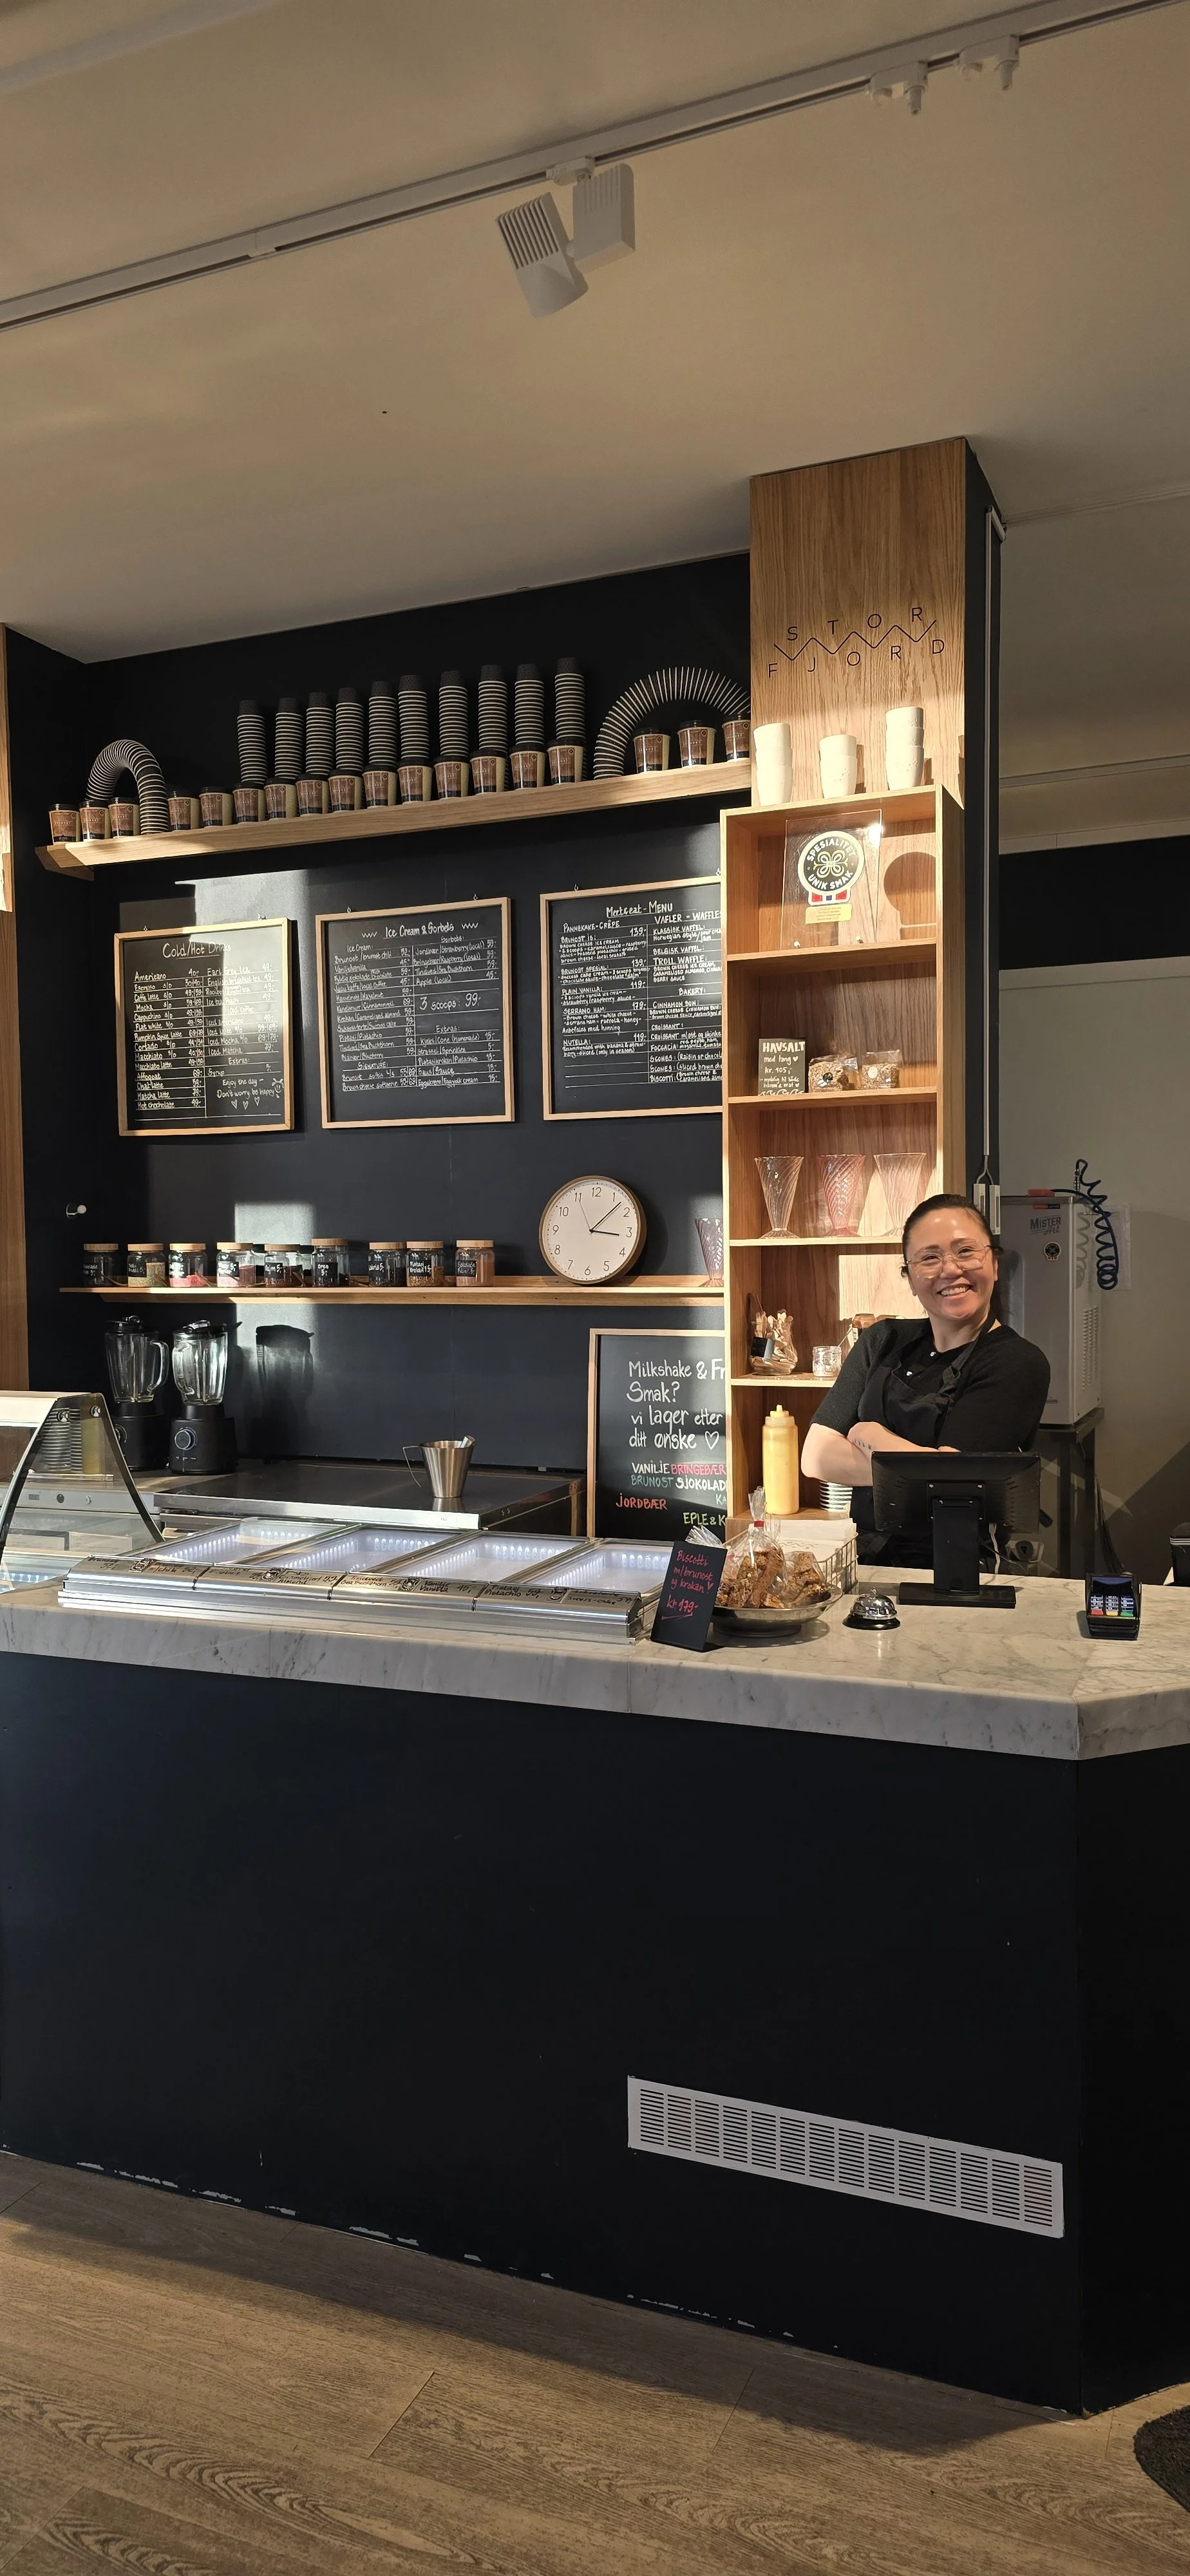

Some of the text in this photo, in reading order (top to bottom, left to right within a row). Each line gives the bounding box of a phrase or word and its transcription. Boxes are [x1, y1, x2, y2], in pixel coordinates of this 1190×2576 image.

[807, 838, 856, 862] SPESIALITET
[808, 870, 853, 890] UNIK SMAK
[654, 913, 683, 924] VAFLER
[386, 927, 397, 938] Ice
[399, 925, 420, 937] Cream
[428, 922, 454, 934] Sorbets
[163, 941, 231, 958] Cold/Hot Drinks
[653, 957, 675, 966] TROLL
[135, 971, 166, 981] Americano
[207, 968, 222, 976] Earl
[416, 978, 432, 988] Apple
[419, 996, 428, 1010] 3
[134, 1041, 158, 1051] Cortado
[208, 1046, 221, 1056] Iced
[762, 1041, 805, 1053] HAVSALT
[135, 1052, 163, 1061] Macchiato
[779, 1055, 791, 1065] tang
[207, 1068, 225, 1077] Syrup
[222, 1079, 236, 1088] Enjoy
[248, 1078, 257, 1086] day
[260, 1088, 274, 1097] happy
[574, 1193, 582, 1202] 11
[592, 1187, 601, 1197] 12
[612, 1192, 616, 1202] 1
[559, 1206, 569, 1217] 10
[623, 1207, 630, 1217] 2
[1030, 1217, 1061, 1230] MISTER
[552, 1225, 559, 1235] 9
[626, 1227, 632, 1238] 3
[554, 1244, 560, 1255] 8
[619, 1247, 626, 1257] 4
[568, 1260, 573, 1270] 7
[584, 1265, 591, 1276] 6
[603, 1260, 610, 1271] 5
[628, 1359, 692, 1378] Milkshake
[696, 1361, 707, 1379] &
[626, 1381, 680, 1403] Smak?
[631, 1405, 722, 1434] vi lager etter
[628, 1427, 697, 1448] ditt ønske
[632, 1460, 726, 1475] VANILJE BRINGEBÆR
[631, 1475, 727, 1492] BRUNOST SJOKOLAD
[616, 1493, 667, 1510] JORDBÆR
[683, 1512, 708, 1525] EPLE
[710, 1517, 717, 1525] &
[677, 1549, 708, 1566] Biscotti
[674, 1566, 713, 1581] m/brunost
[681, 1578, 704, 1594] krokan
